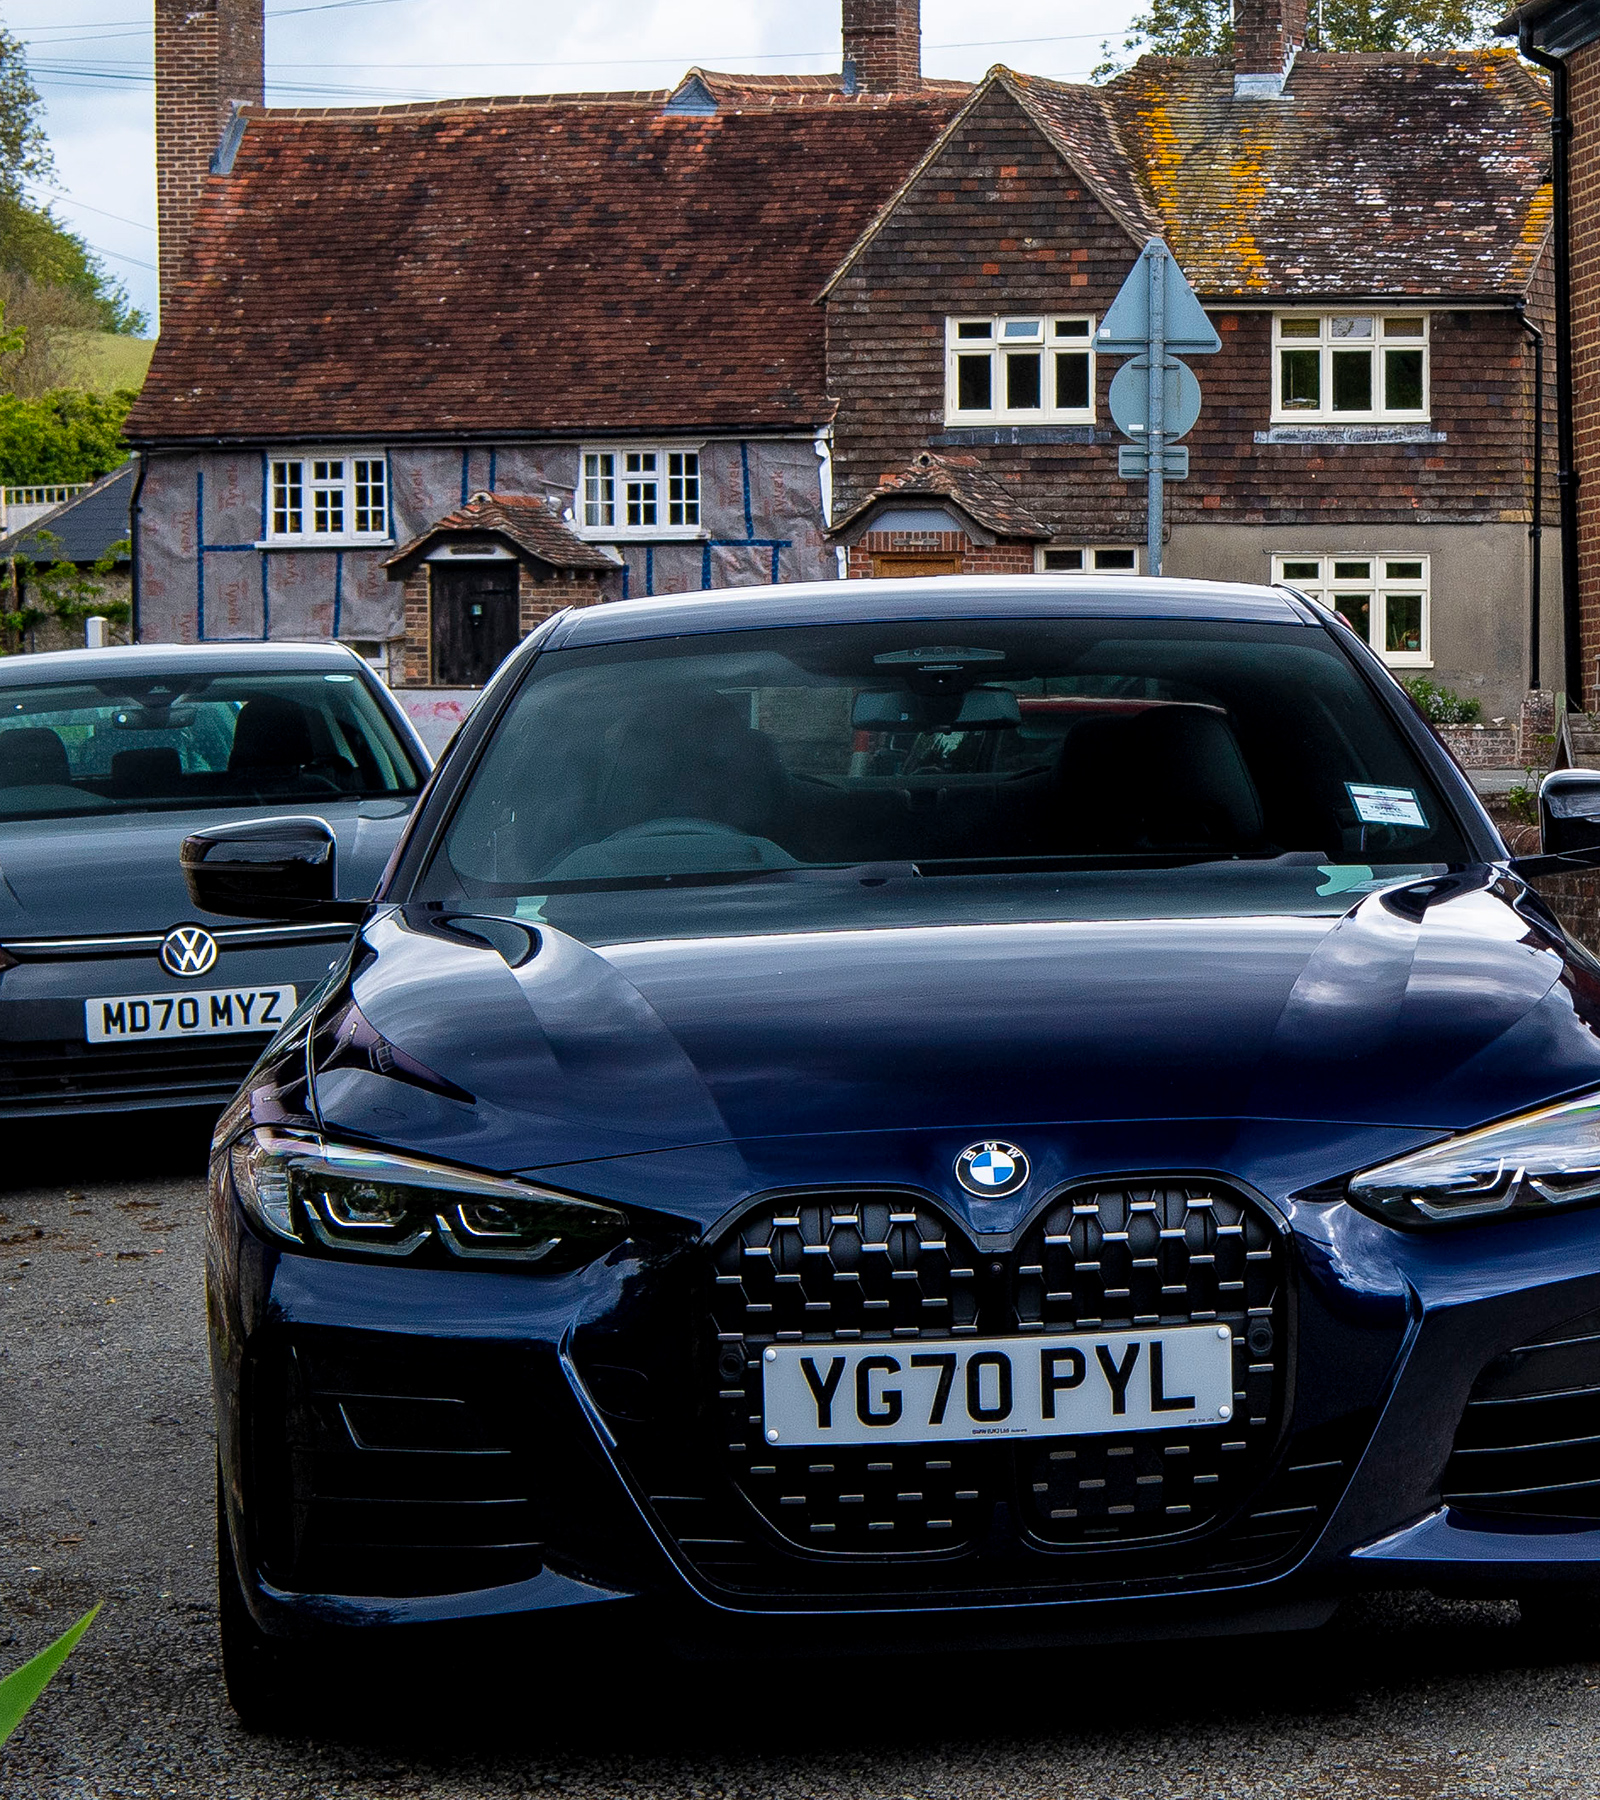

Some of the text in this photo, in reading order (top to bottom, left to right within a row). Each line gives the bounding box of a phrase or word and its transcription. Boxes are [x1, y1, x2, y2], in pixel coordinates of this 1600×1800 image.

[727, 460, 742, 505] Tyvek
[772, 469, 786, 515] Tyvek
[225, 583, 240, 626] Tyvek
[103, 991, 283, 1035] MD70 MYZ
[962, 1143, 1021, 1161] BMW
[799, 1340, 1197, 1430] YG70 PYL
